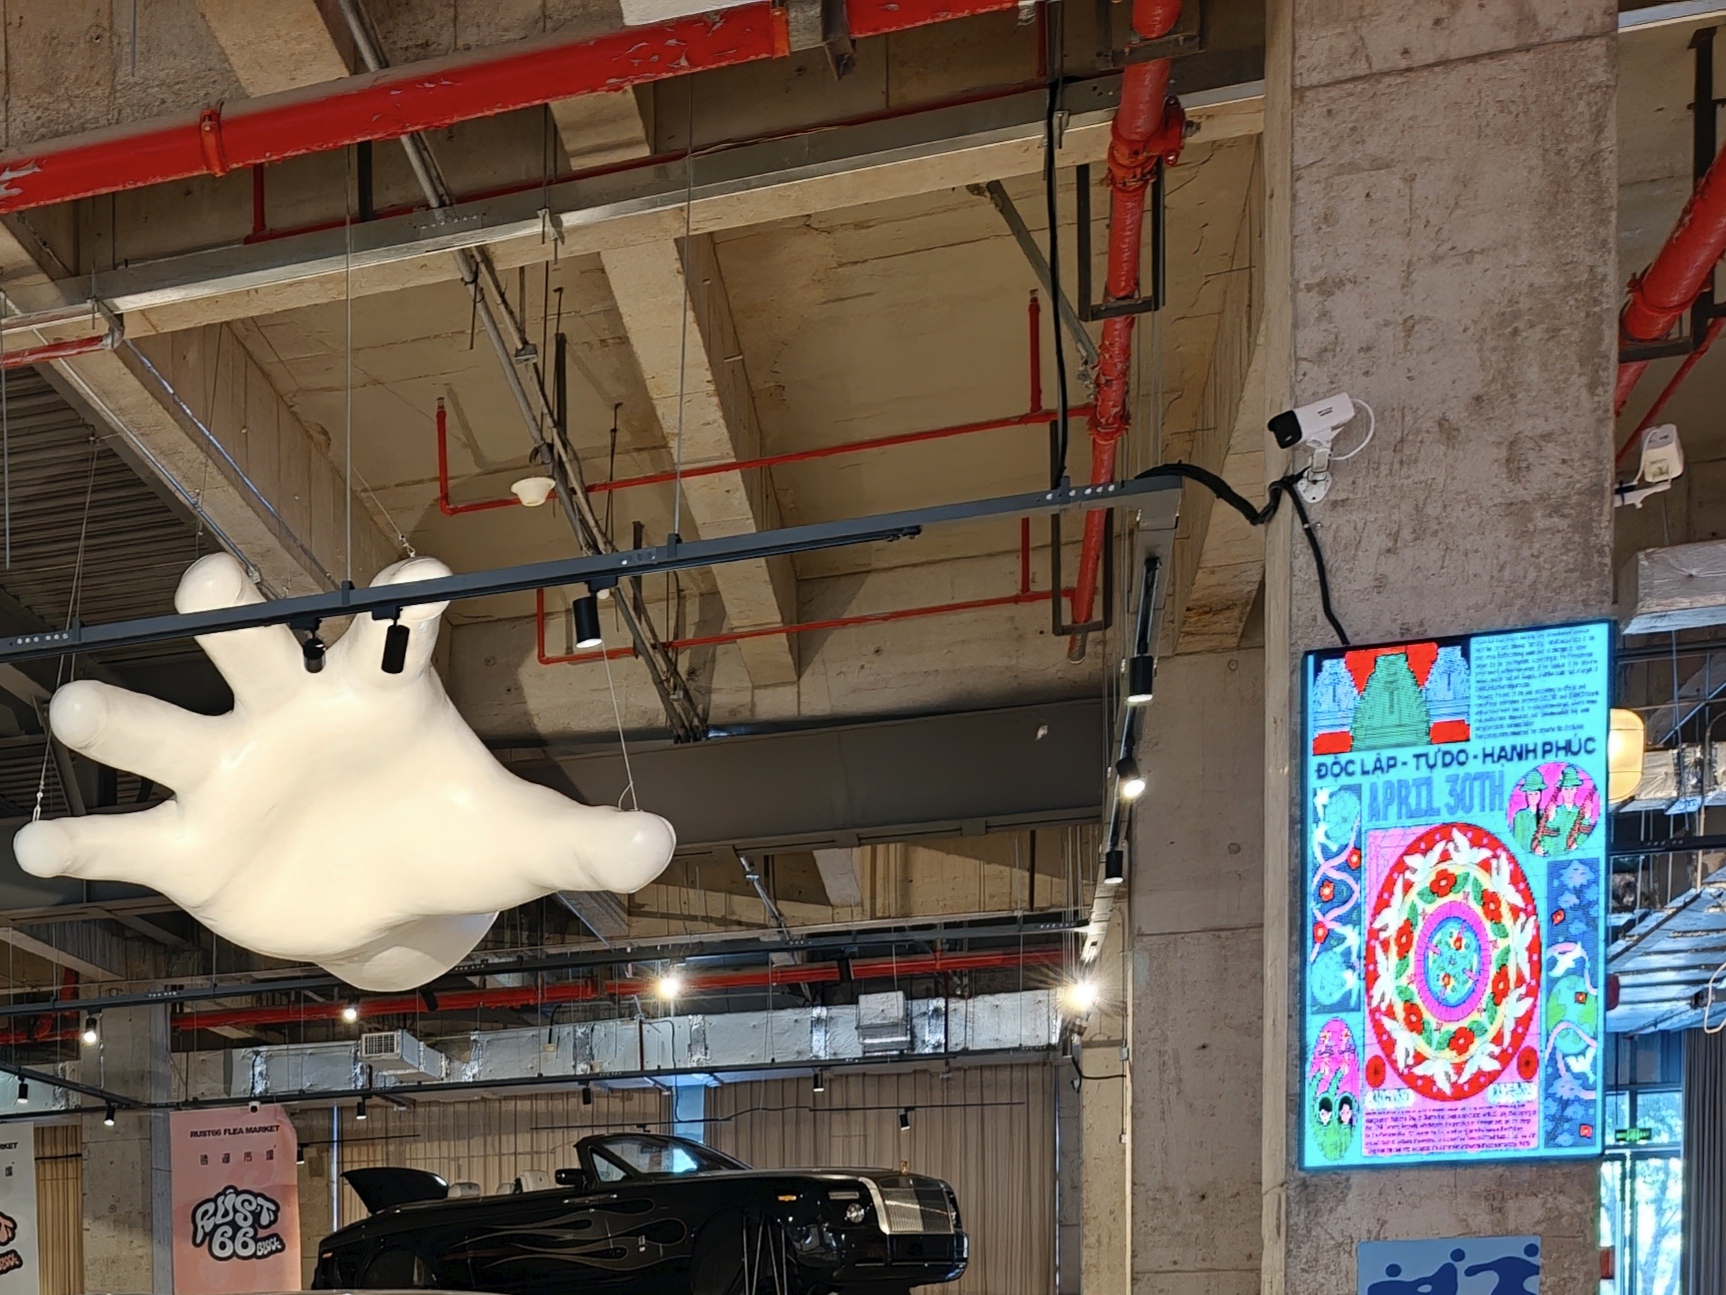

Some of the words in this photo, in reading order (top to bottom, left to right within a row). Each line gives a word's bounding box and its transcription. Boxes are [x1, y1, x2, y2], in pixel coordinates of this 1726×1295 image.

[1367, 776, 1441, 822] APRIL
[1445, 770, 1504, 813] 30TH
[224, 1127, 244, 1136] FLEA
[246, 1125, 280, 1135] MARKET
[212, 1225, 256, 1258] 66
